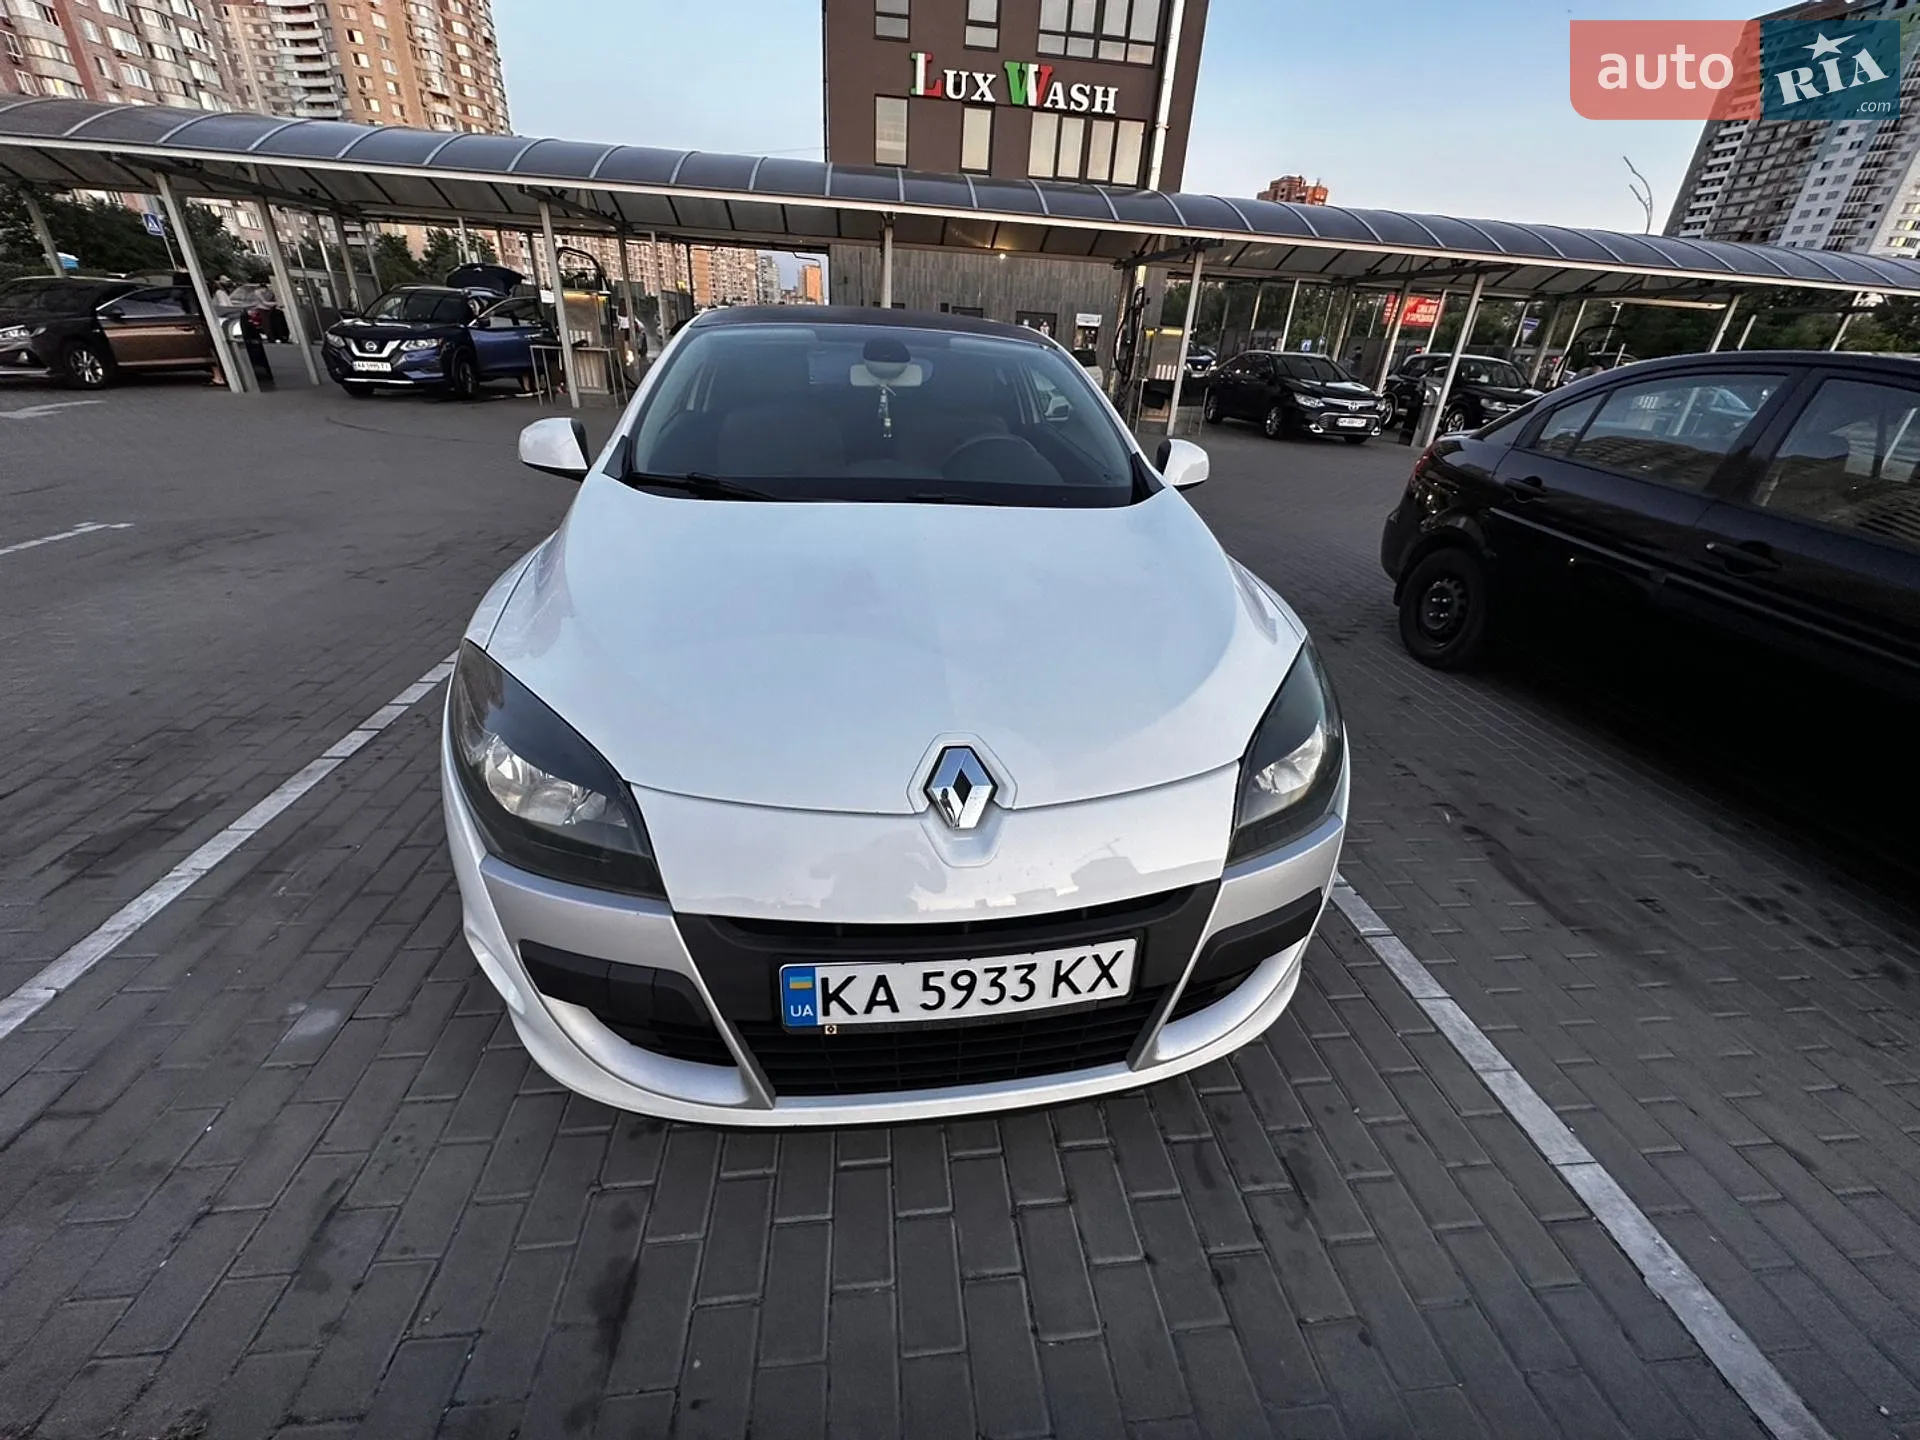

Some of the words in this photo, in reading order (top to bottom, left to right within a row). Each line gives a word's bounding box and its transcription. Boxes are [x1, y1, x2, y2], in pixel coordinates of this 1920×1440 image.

[910, 51, 997, 102] LUX
[1003, 59, 1119, 115] WASH
[790, 1004, 815, 1017] UA
[820, 974, 900, 1017] KA
[919, 962, 1038, 1011] 5933
[1051, 949, 1125, 999] KX
